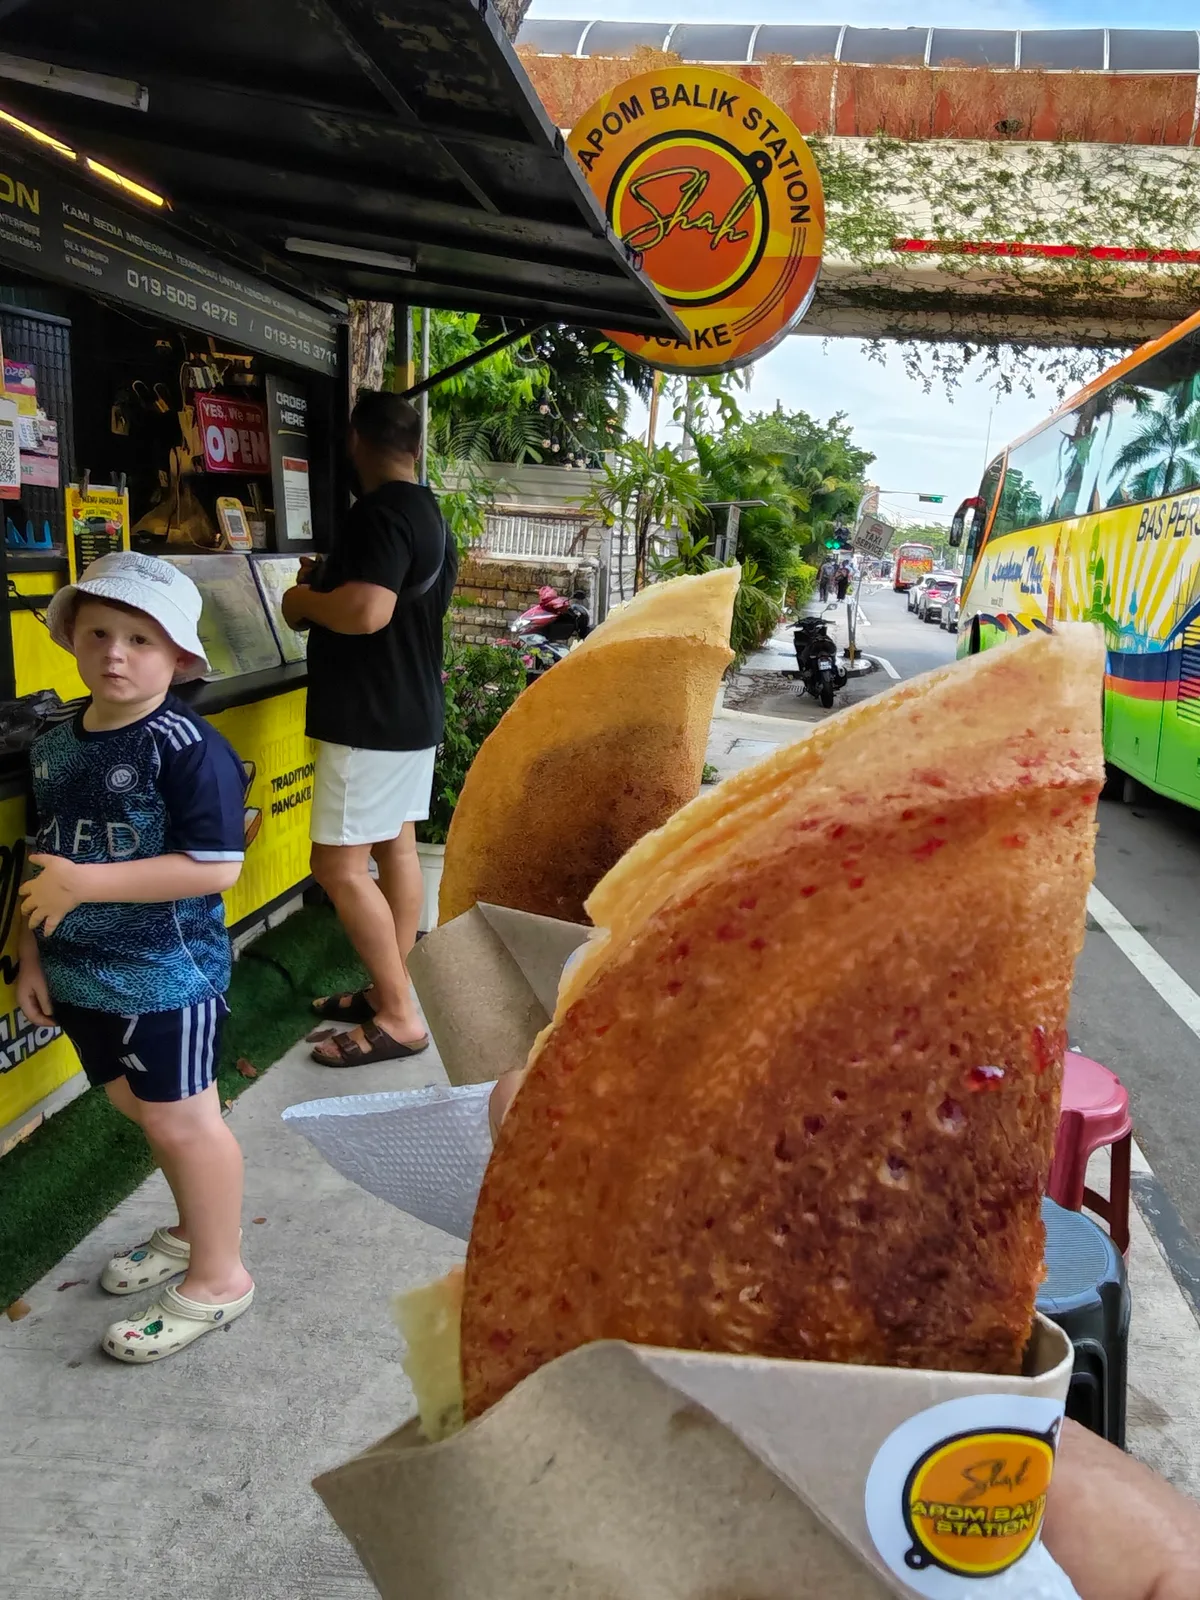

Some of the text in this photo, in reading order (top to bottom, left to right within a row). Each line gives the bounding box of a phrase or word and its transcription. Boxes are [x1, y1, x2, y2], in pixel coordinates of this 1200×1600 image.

[577, 83, 812, 224] APOM BALIK STATION
[62, 202, 91, 223] KAMI
[93, 216, 124, 239] SEDIA
[622, 165, 757, 252] Shah
[202, 300, 238, 327] 4275
[313, 344, 338, 366] 3711
[203, 403, 227, 421] YES,
[228, 407, 243, 422] We
[276, 391, 307, 411] ORDER
[280, 410, 305, 427] HERE
[206, 425, 269, 463] OPEN
[1136, 503, 1168, 542] BAS
[855, 536, 884, 556] SERVICE
[866, 530, 883, 545] TAXI
[271, 785, 312, 819] PANCAKE
[911, 1501, 988, 1523] APOM
[934, 1515, 1034, 1538] STATION
